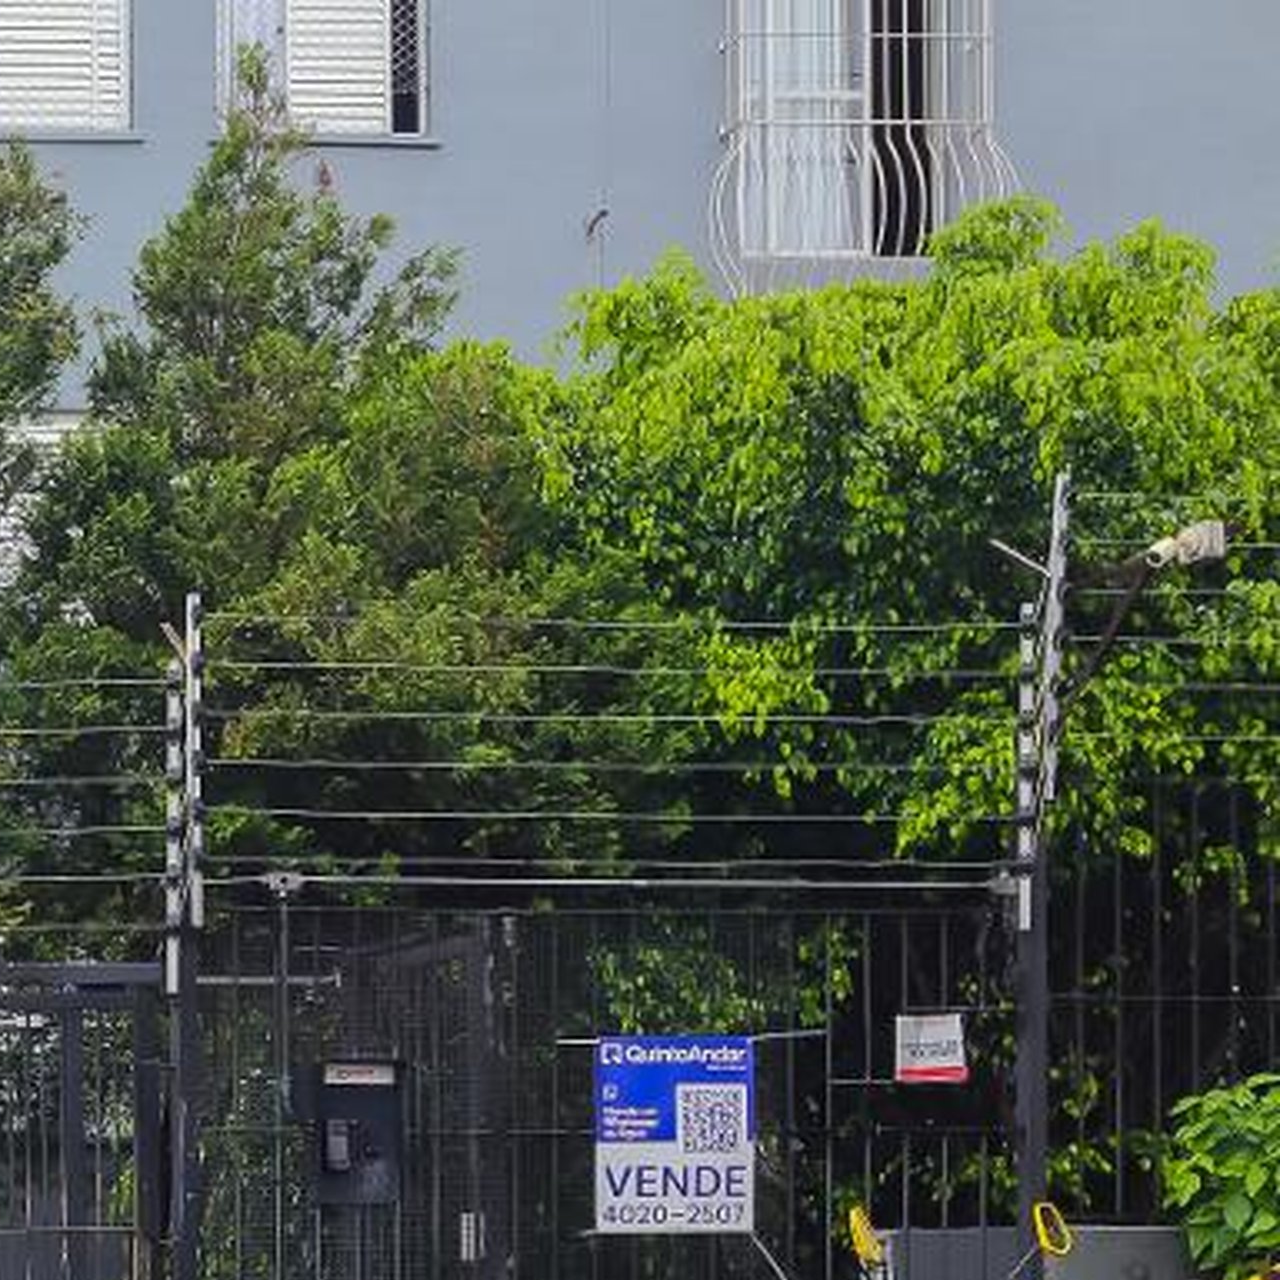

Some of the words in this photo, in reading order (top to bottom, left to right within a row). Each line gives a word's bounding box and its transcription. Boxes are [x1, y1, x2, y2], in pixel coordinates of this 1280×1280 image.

[625, 1044, 747, 1064] QuintoAndar
[604, 1165, 748, 1198] VENDE
[602, 1204, 746, 1225] 4020-2507
